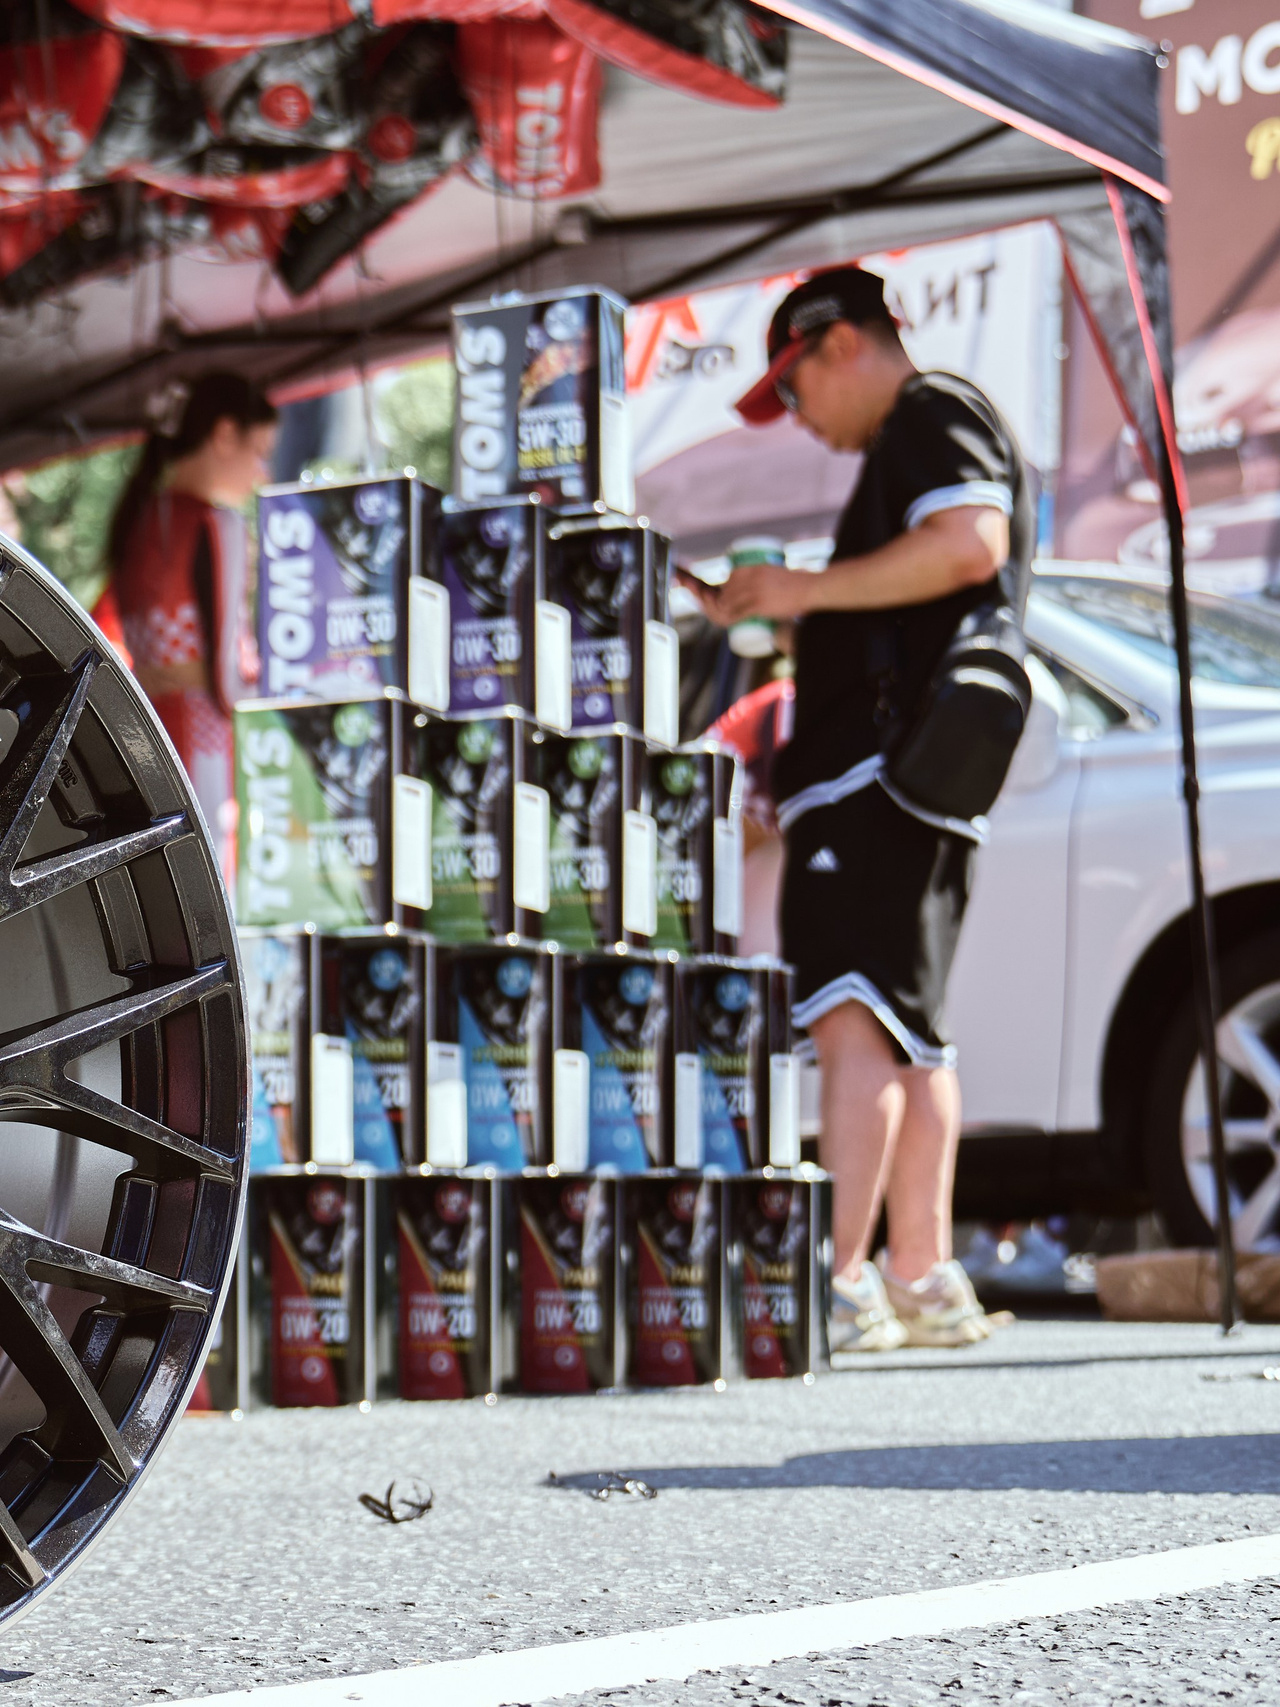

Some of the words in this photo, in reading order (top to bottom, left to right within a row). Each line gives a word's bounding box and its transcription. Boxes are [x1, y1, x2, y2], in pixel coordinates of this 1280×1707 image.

[456, 325, 507, 501] TOM'S
[519, 420, 586, 452] 5W-30
[263, 509, 316, 694] TOM'S
[327, 611, 396, 646] 0W-30
[453, 631, 521, 665] 0W-30
[241, 728, 293, 913] TOM'S
[307, 831, 379, 868] 5W-30
[432, 848, 501, 881] 5W-30
[550, 857, 610, 892] W-30
[354, 1073, 410, 1109] W-20
[472, 1078, 539, 1112] 0W-20
[594, 1083, 659, 1117] 0W-20
[703, 1085, 755, 1118] W-20
[280, 1310, 349, 1343] 0W-20
[408, 1306, 477, 1339] 0W-20
[534, 1302, 602, 1334] 0W-20
[642, 1301, 708, 1329] 0W-20
[745, 1297, 799, 1327] W-20
